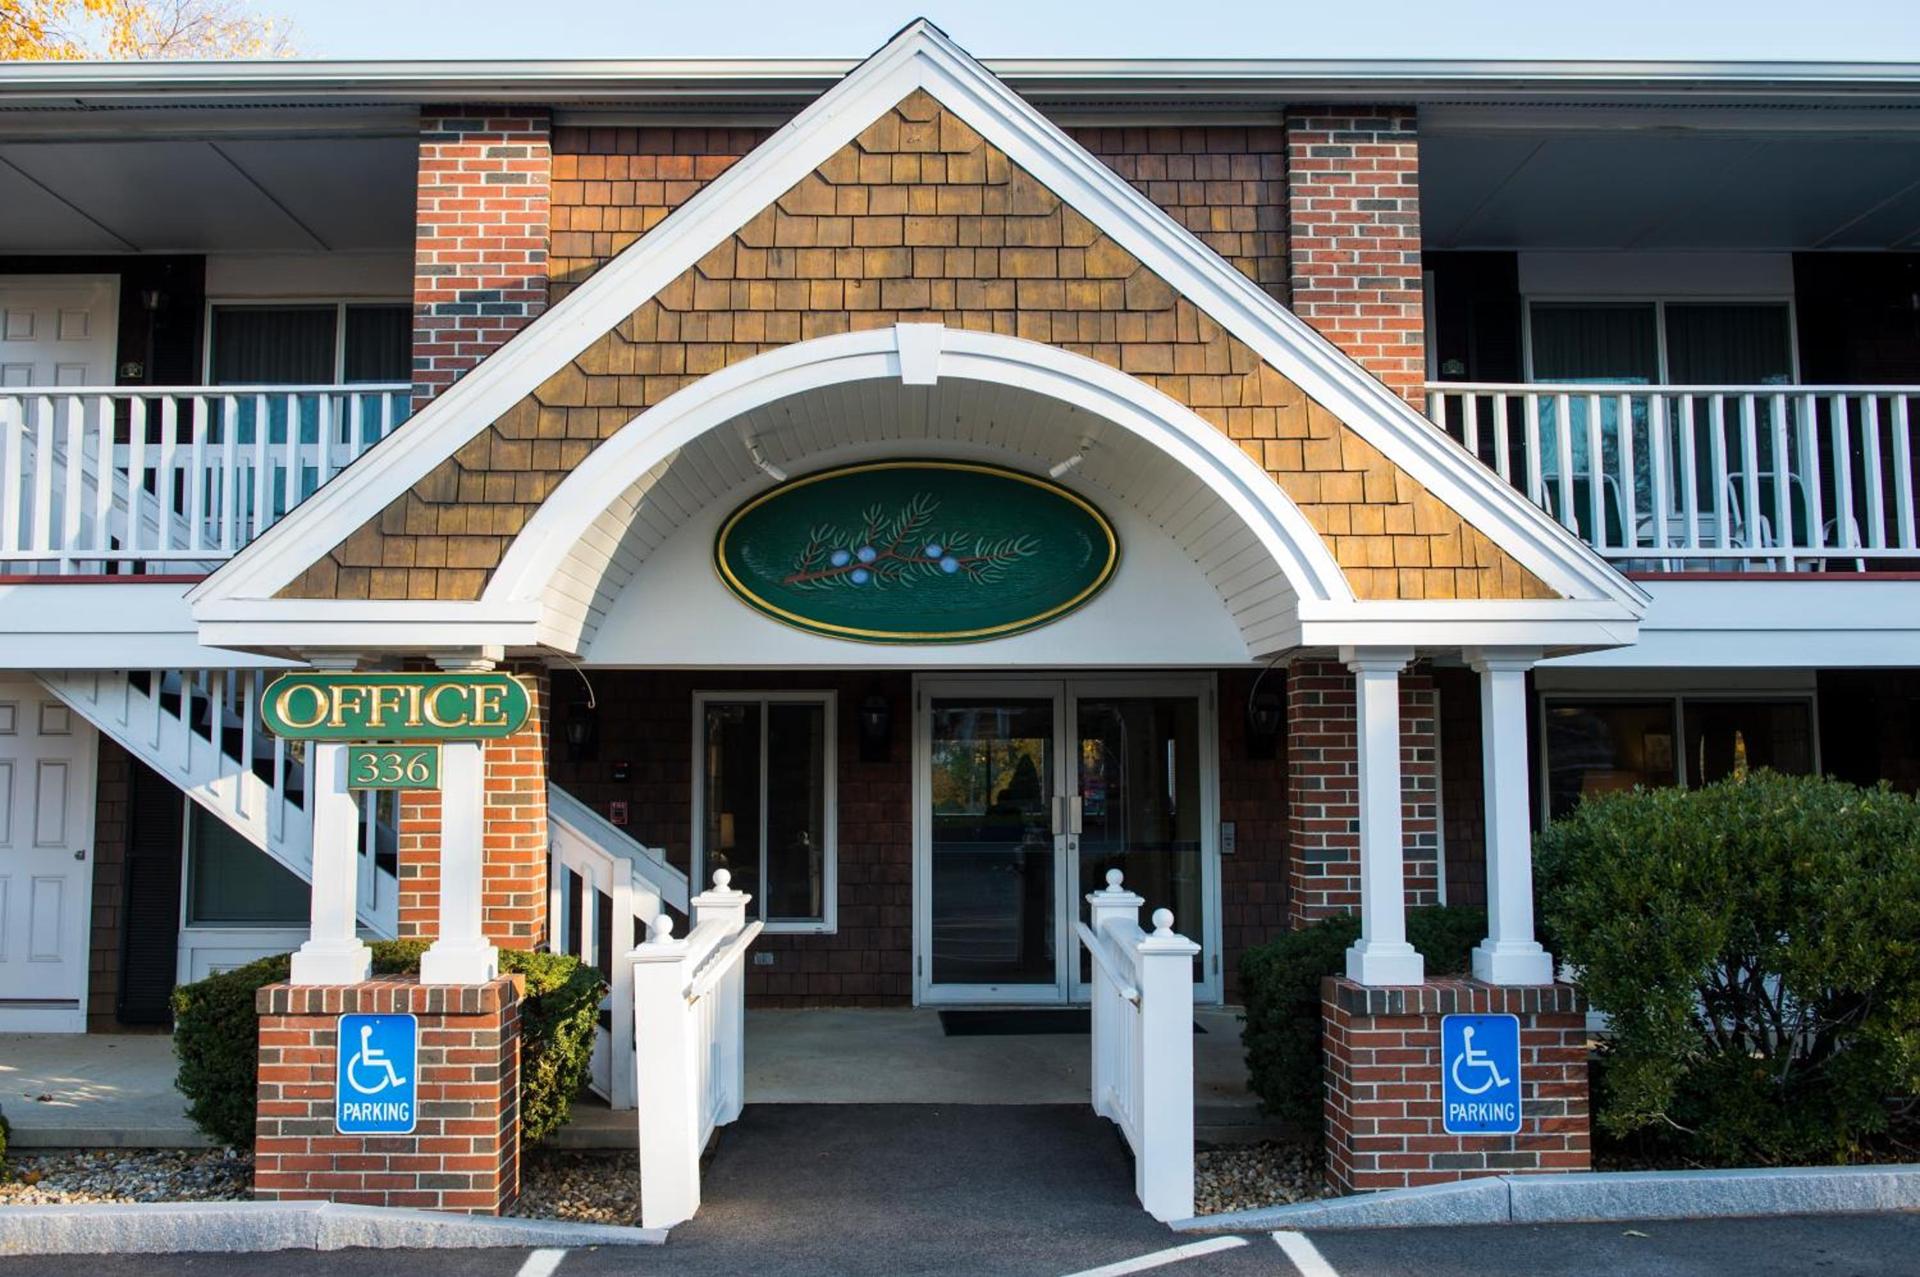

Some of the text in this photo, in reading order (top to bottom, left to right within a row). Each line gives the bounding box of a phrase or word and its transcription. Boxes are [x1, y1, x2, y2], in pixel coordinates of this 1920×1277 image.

[275, 683, 508, 728] OFFICE
[357, 752, 430, 782] 336
[343, 1102, 409, 1122] PARKING
[1449, 1102, 1515, 1122] PARKING
